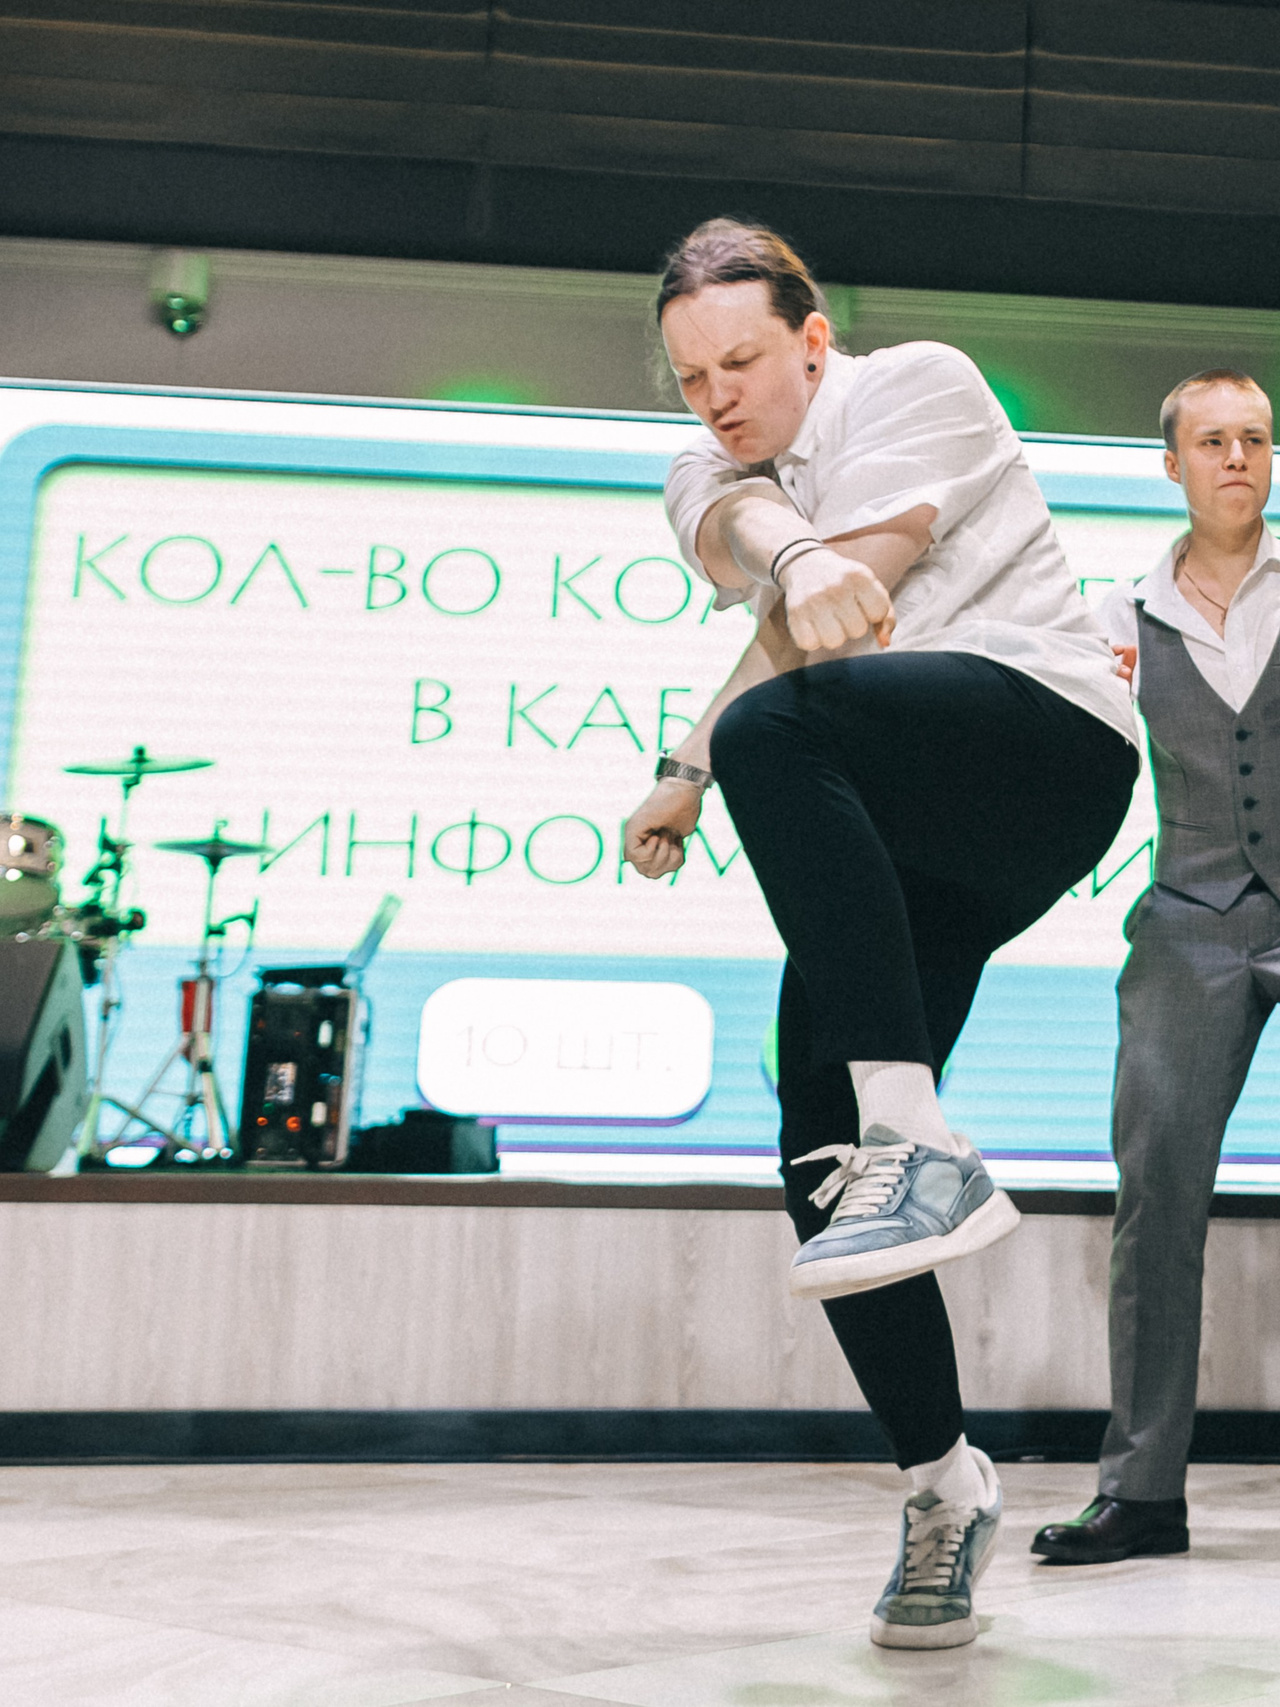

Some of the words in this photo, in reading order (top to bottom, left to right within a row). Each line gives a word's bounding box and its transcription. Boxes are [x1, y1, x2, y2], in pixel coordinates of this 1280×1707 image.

[72, 533, 501, 615] КОЛ-ВО
[410, 677, 454, 744] В
[456, 1024, 528, 1067] 10
